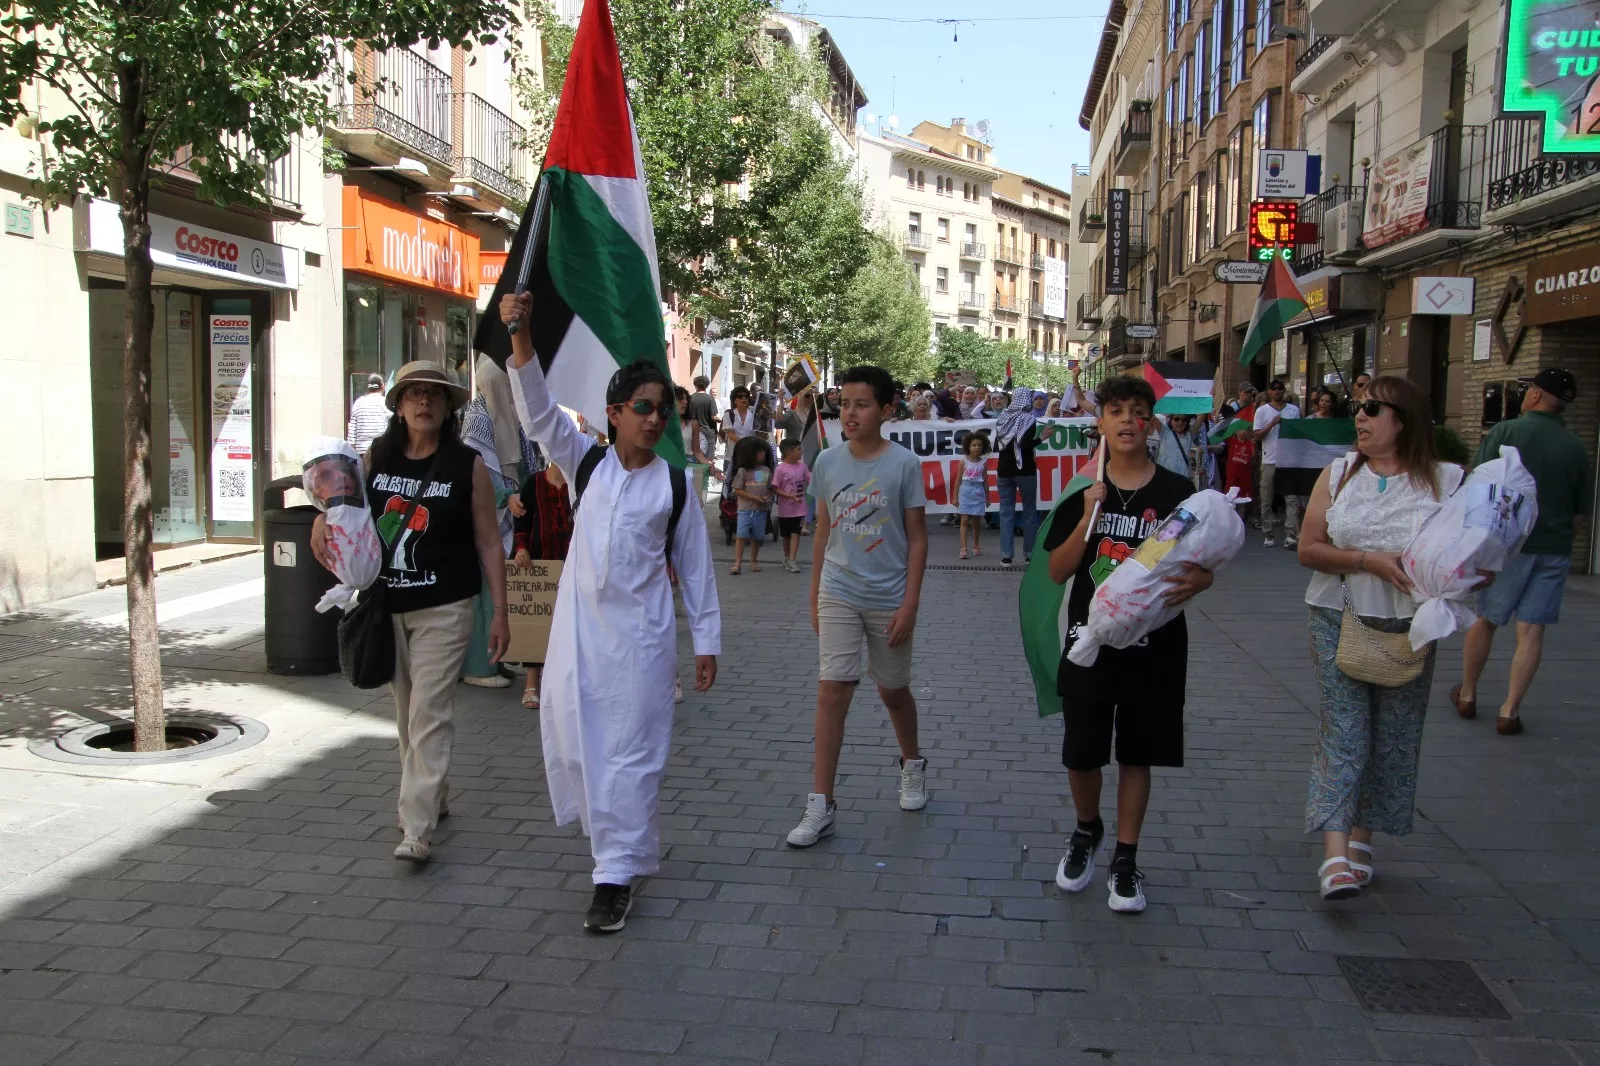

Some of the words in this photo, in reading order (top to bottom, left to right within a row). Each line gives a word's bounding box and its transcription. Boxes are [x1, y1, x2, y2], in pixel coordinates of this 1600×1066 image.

[1556, 56, 1599, 77] TU
[8, 205, 32, 233] 55
[175, 226, 239, 262] COSTCO
[1113, 191, 1124, 284] Montovelaz
[196, 257, 238, 273] WHOLESALE
[213, 319, 249, 327] COSTCO
[213, 332, 249, 342] Precios
[833, 490, 888, 507] WAITING
[836, 506, 858, 520] FOR
[842, 521, 883, 536] FRIDAY
[522, 593, 533, 602] UN
[507, 602, 553, 617] ENOCIDIO
